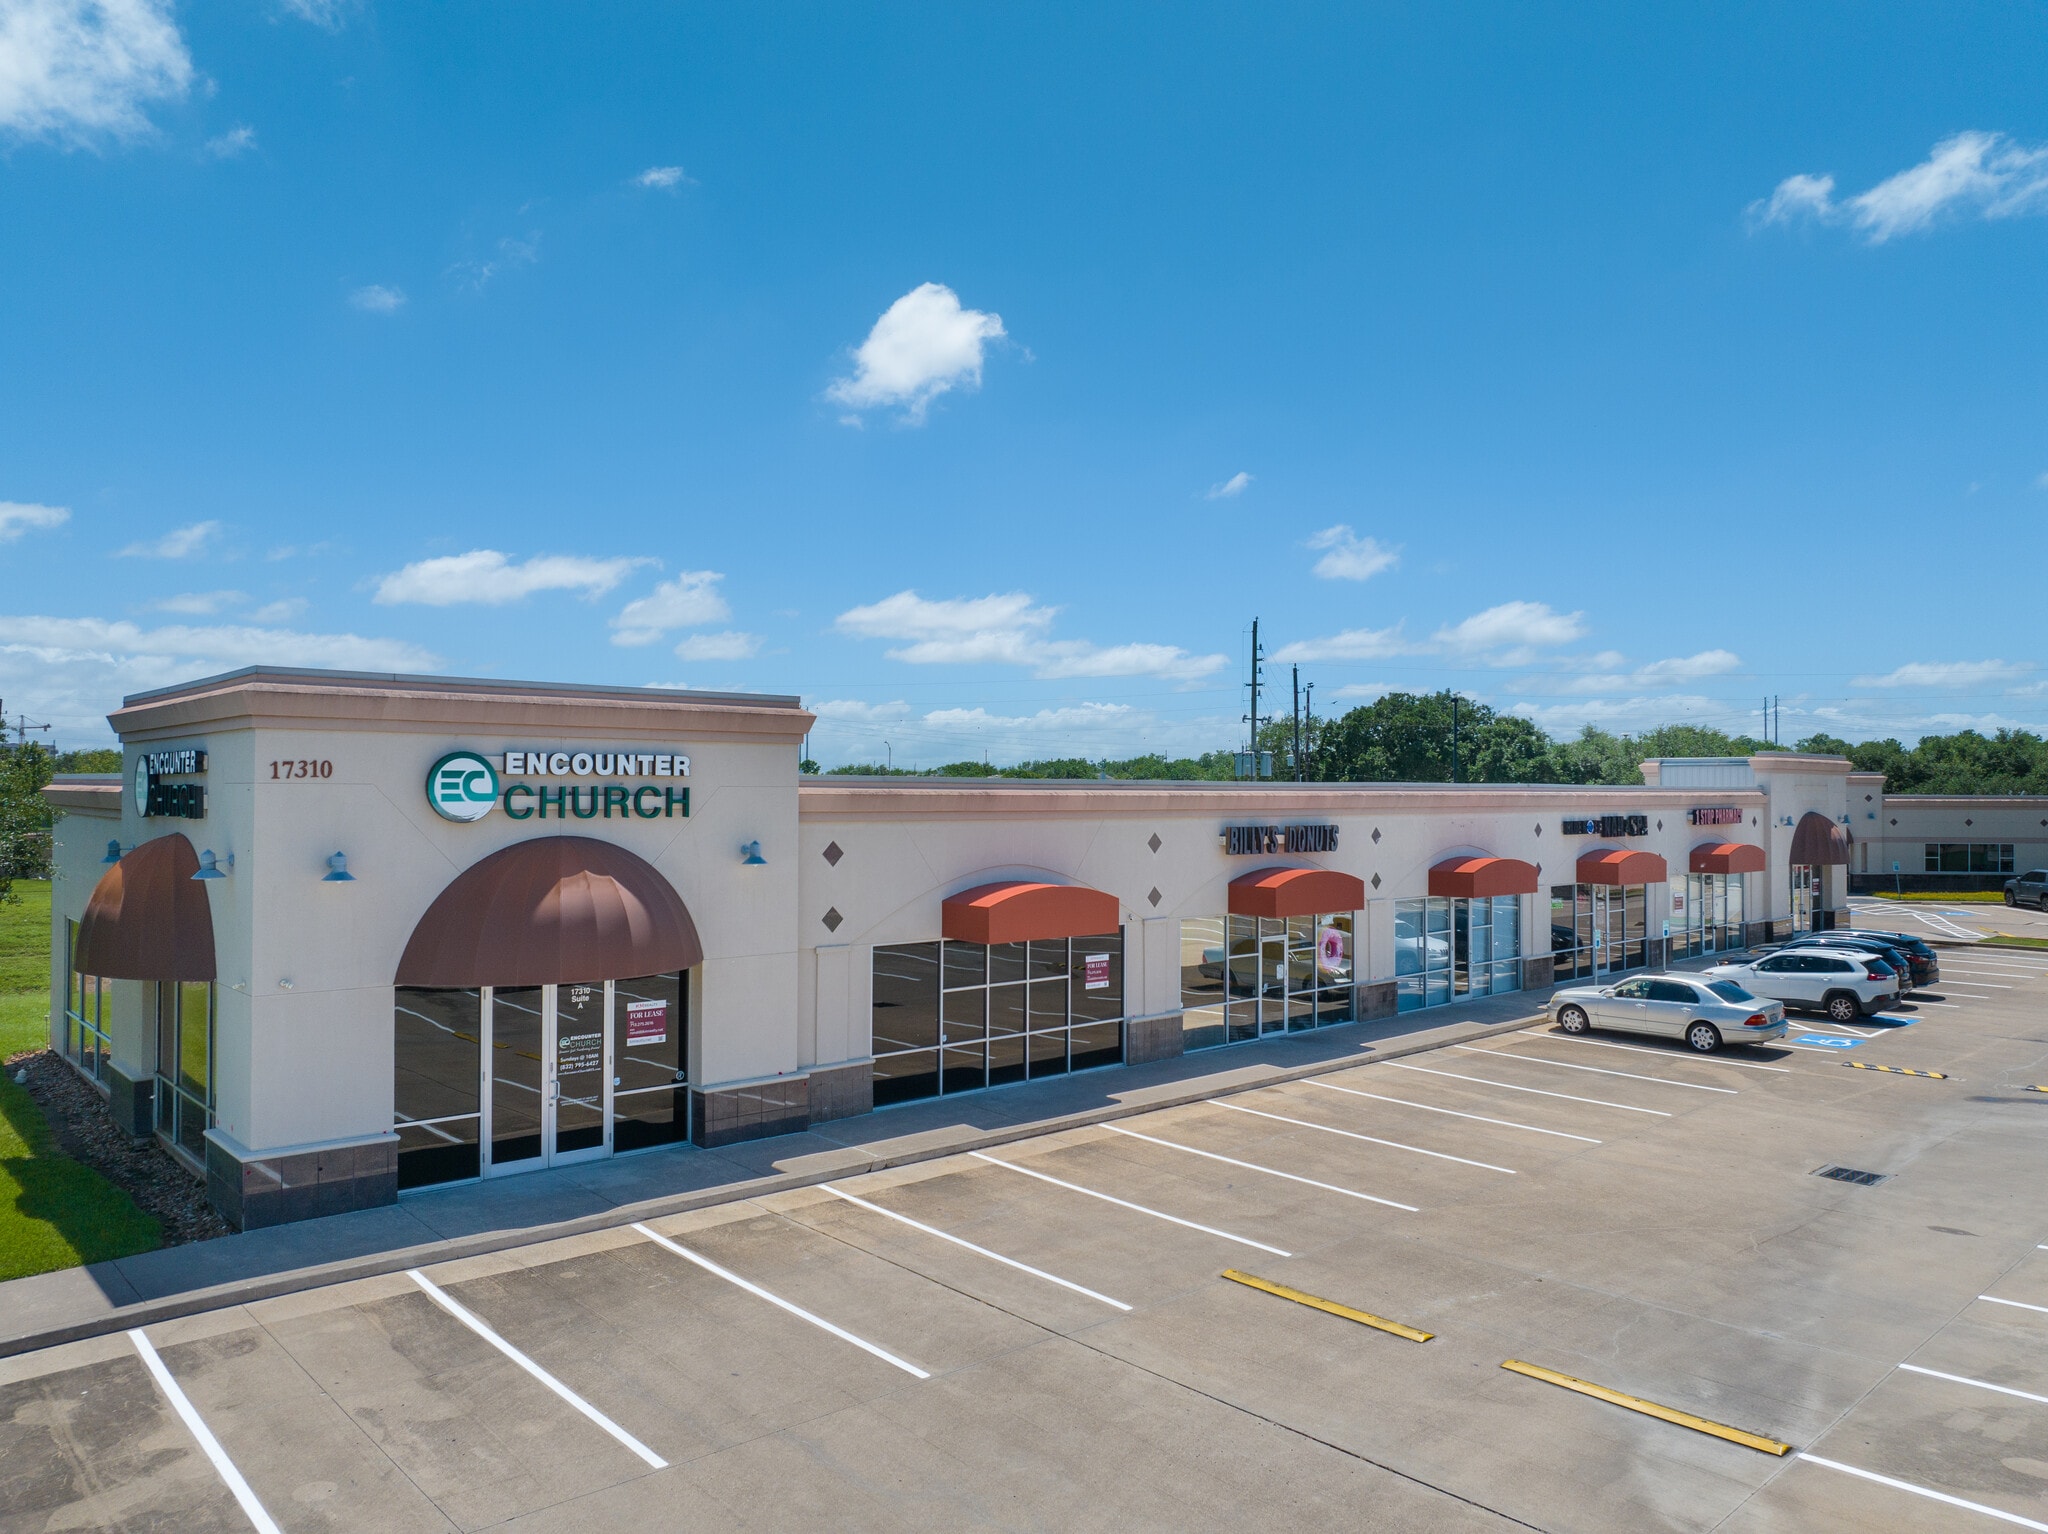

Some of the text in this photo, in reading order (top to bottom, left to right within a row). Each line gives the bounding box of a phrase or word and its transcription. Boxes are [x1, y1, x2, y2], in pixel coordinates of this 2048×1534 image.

[150, 750, 196, 775] ENCOUNTER
[503, 752, 691, 776] ENCOUNTER
[269, 760, 333, 779] 17310
[503, 785, 691, 819] CHURCH
[1694, 808, 1743, 825] 1 STOP PHARMACY
[1227, 824, 1339, 855] BILLY'S DONUTS
[571, 987, 590, 995] 17310
[571, 995, 590, 1003] Suite
[577, 1002, 584, 1010] A
[644, 1010, 664, 1018] LEASE
[570, 1033, 602, 1041] ENCOUNTER
[570, 1039, 602, 1048] CHURCH
